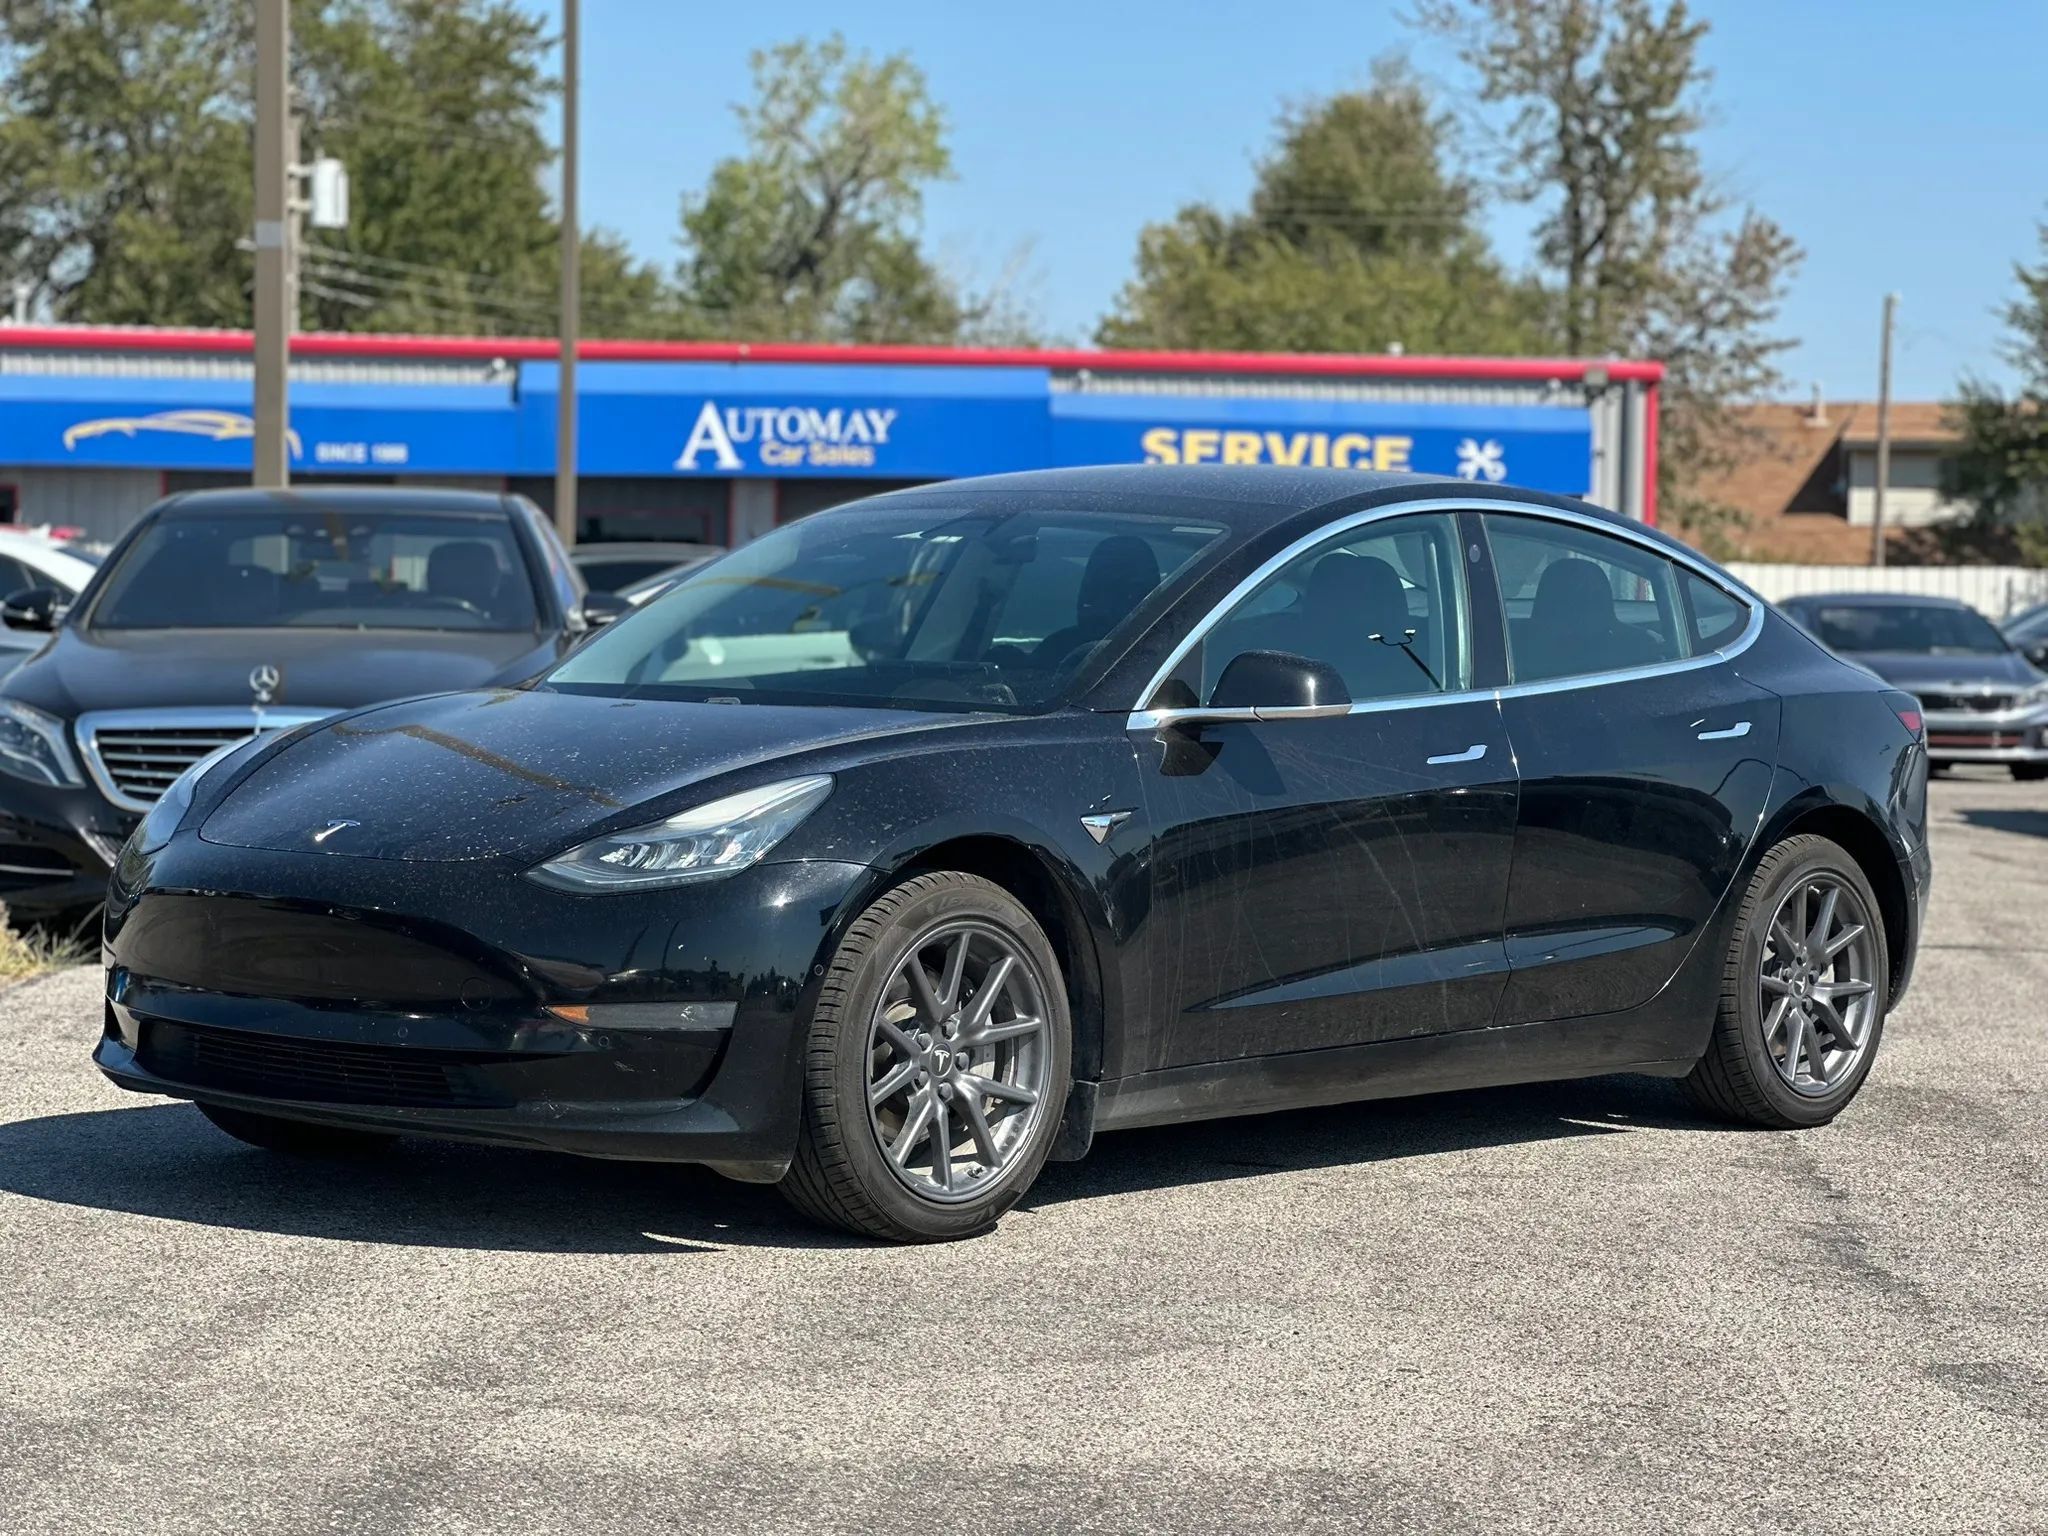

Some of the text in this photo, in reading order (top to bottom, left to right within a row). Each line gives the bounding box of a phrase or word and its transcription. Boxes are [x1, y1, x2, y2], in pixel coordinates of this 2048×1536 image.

[673, 400, 897, 470] AUTOMAY
[759, 439, 876, 467] Car Sales
[1142, 427, 1412, 472] SERVICE
